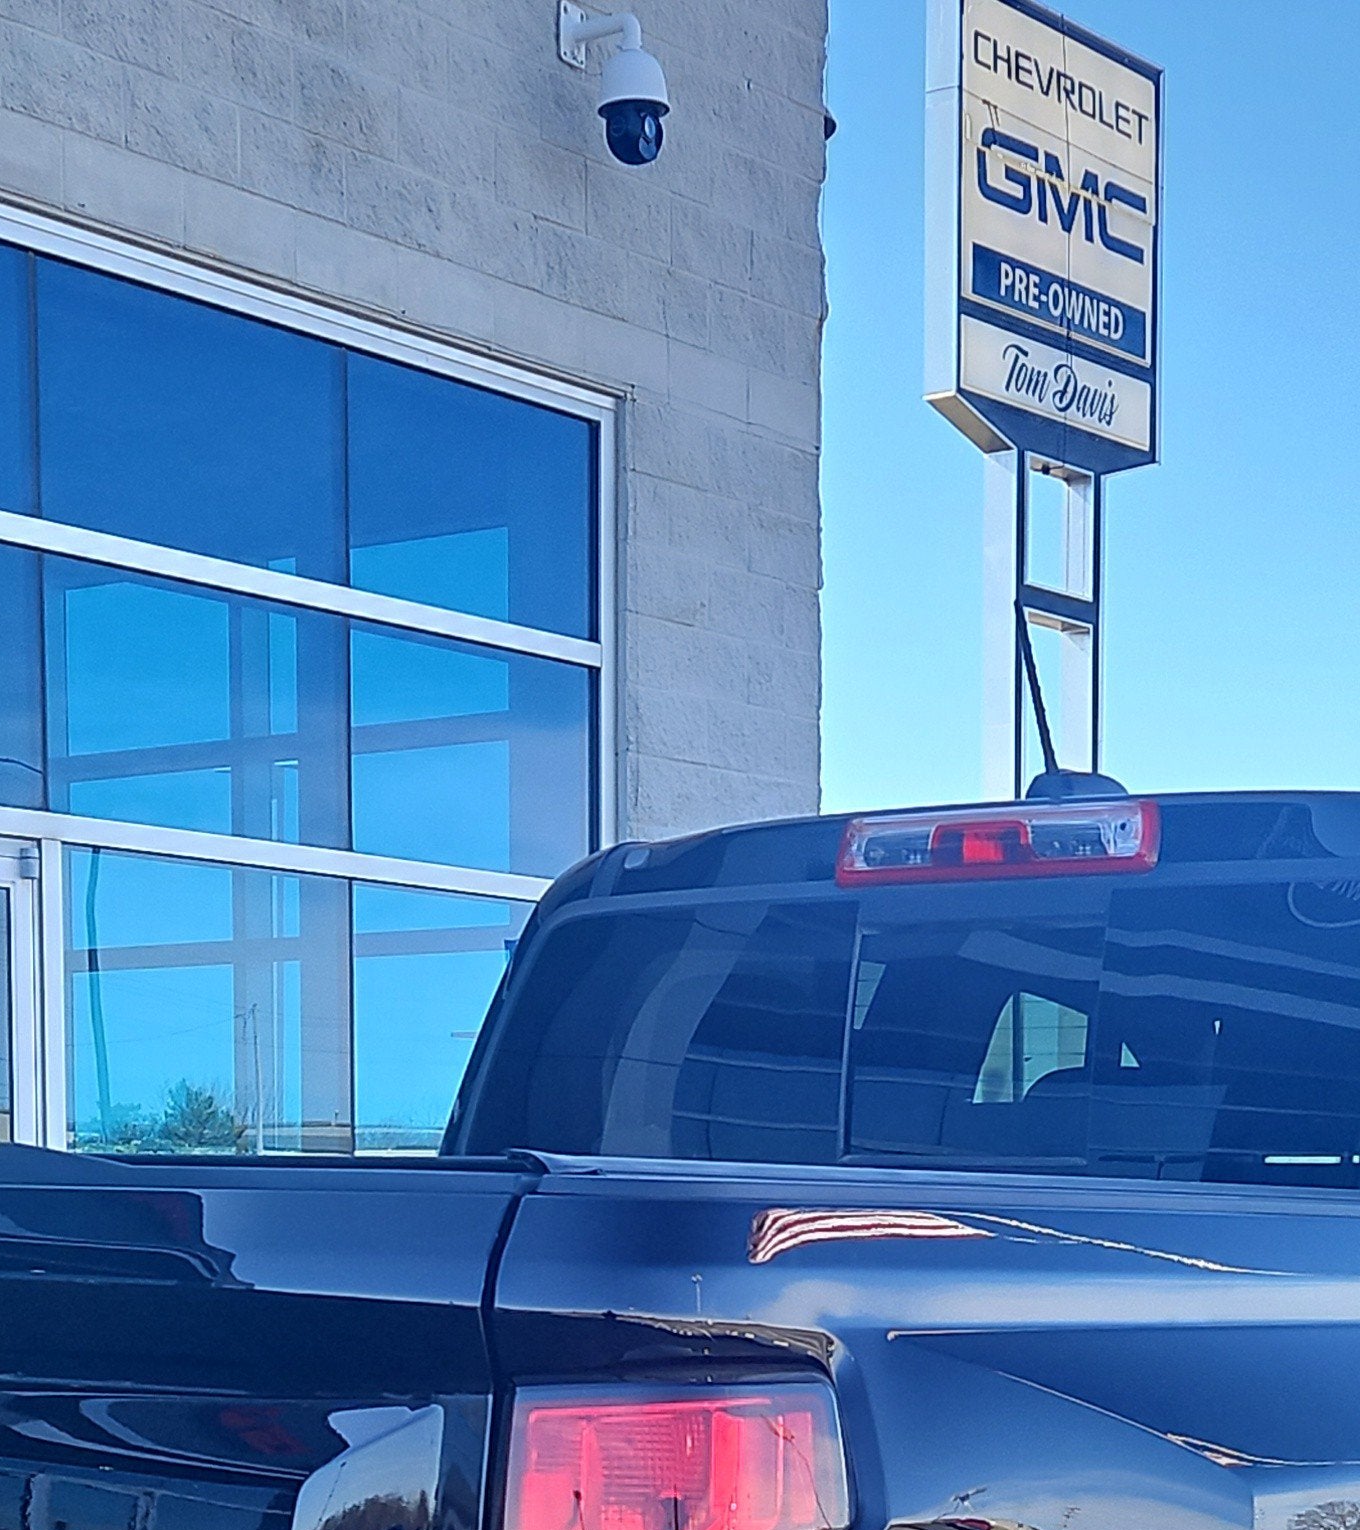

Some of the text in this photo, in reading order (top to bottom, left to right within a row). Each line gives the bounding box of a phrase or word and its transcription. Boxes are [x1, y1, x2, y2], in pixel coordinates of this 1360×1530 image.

[974, 29, 1149, 145] CHEVROLET
[976, 127, 1147, 264] GMC
[1000, 262, 1124, 340] PRE-OWNED
[1003, 344, 1120, 426] Tom Davis
